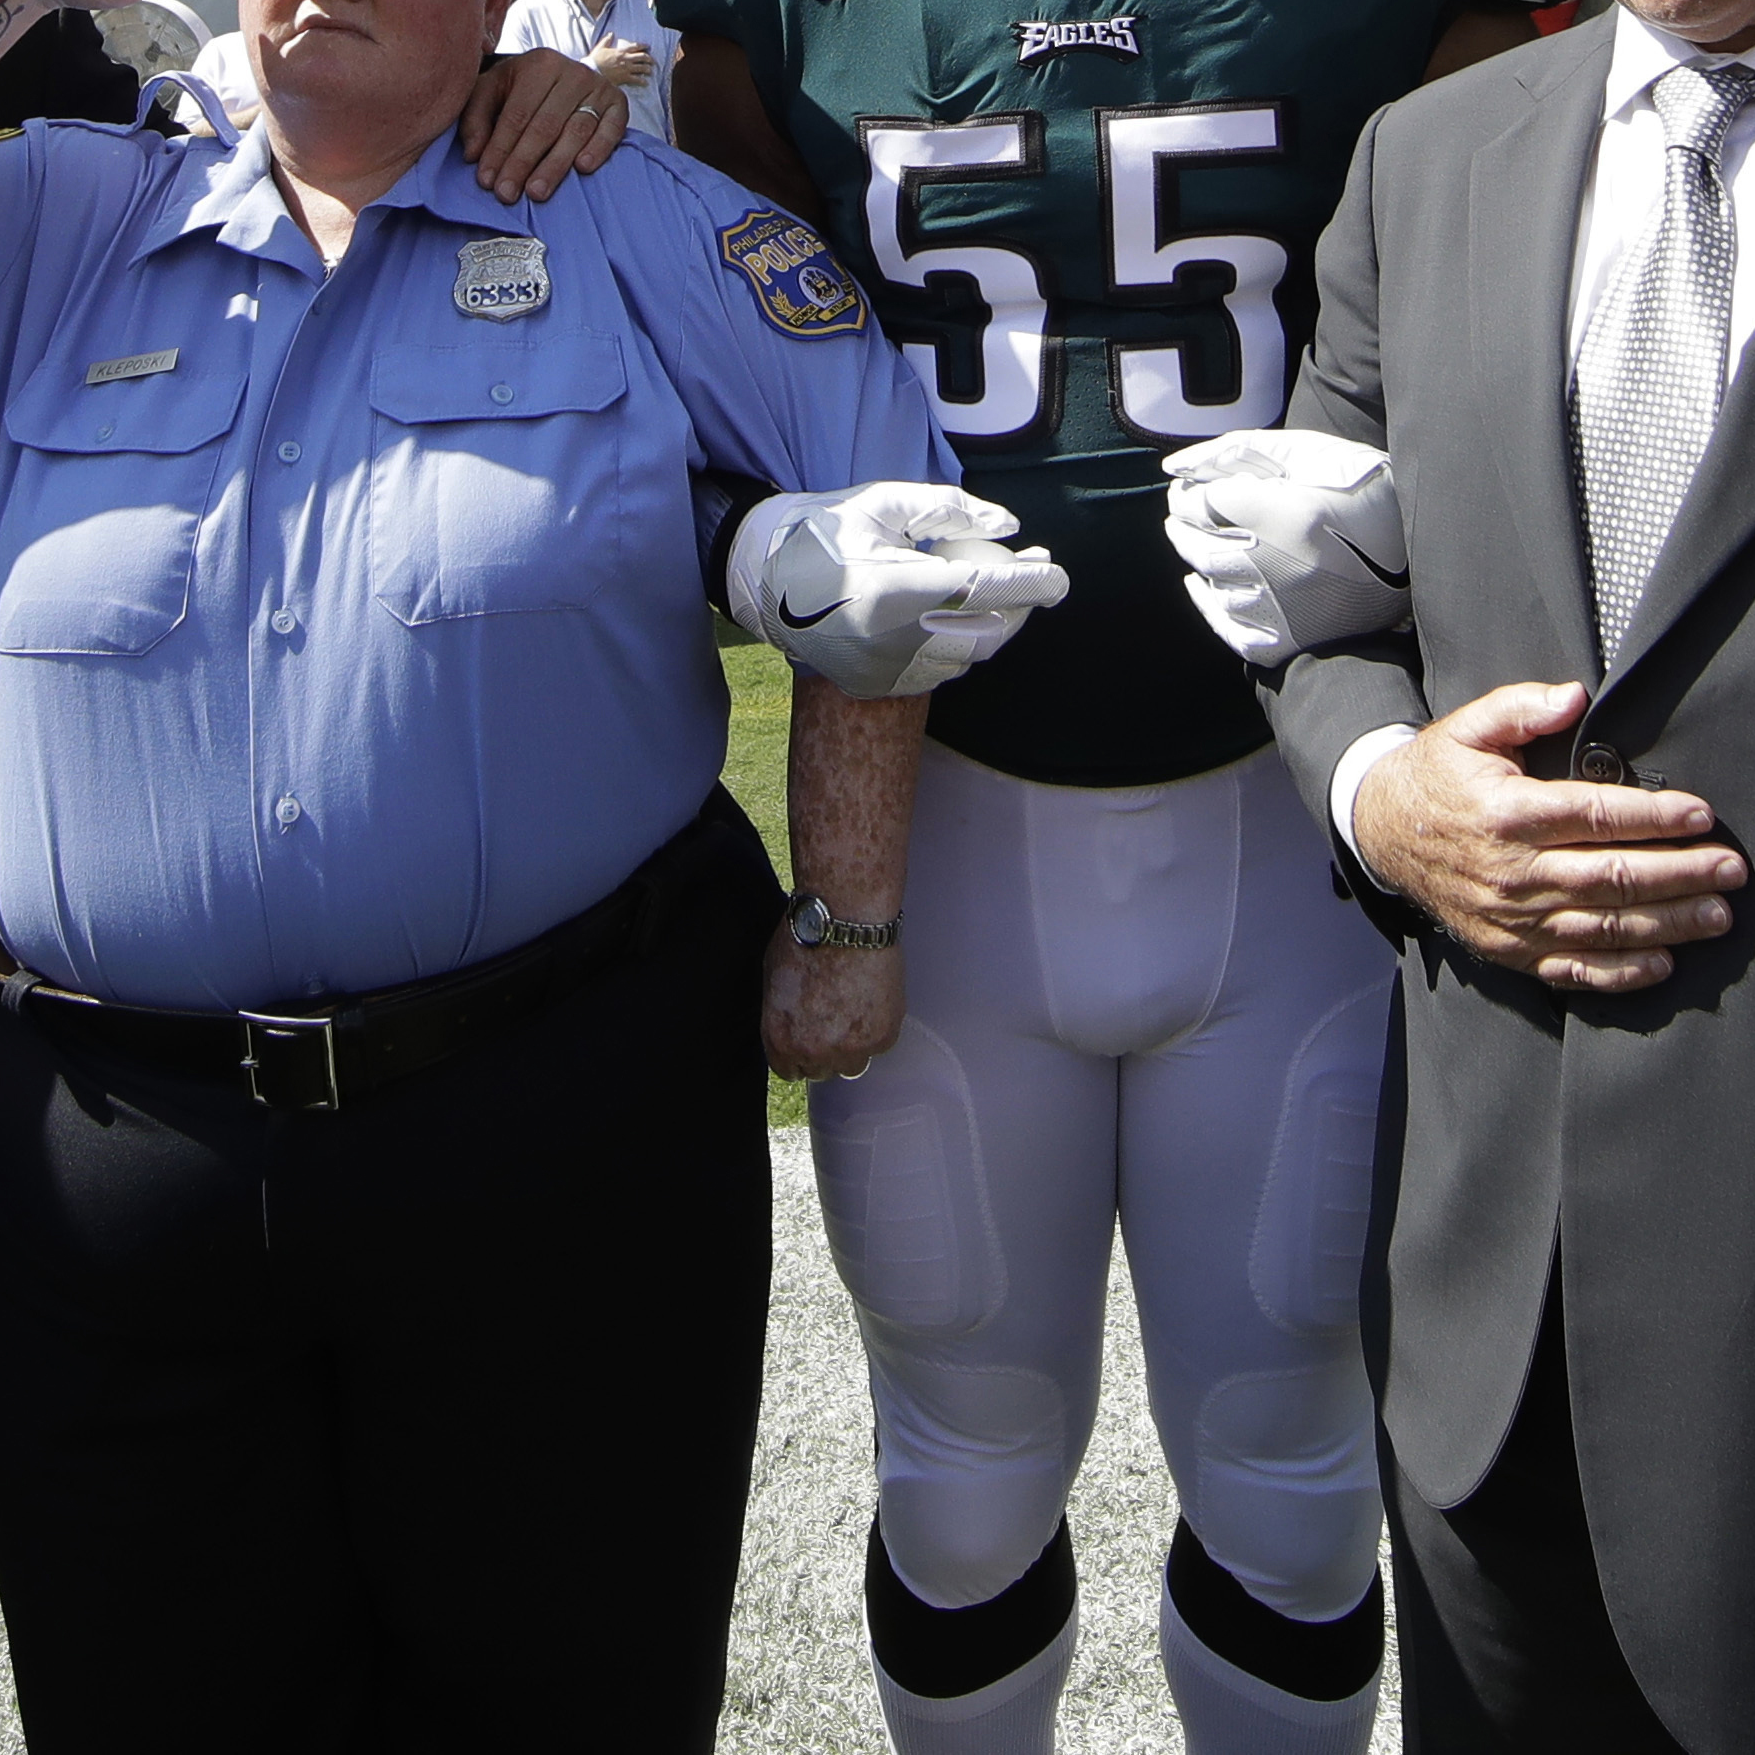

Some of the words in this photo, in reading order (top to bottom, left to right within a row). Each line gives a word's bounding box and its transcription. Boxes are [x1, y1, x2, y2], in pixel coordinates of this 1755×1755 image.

[1020, 16, 1141, 59] EAGLES
[742, 226, 827, 286] POLICE
[856, 100, 1290, 443] 55
[466, 279, 537, 307] 6333
[96, 354, 167, 377] KLEPOSKI
